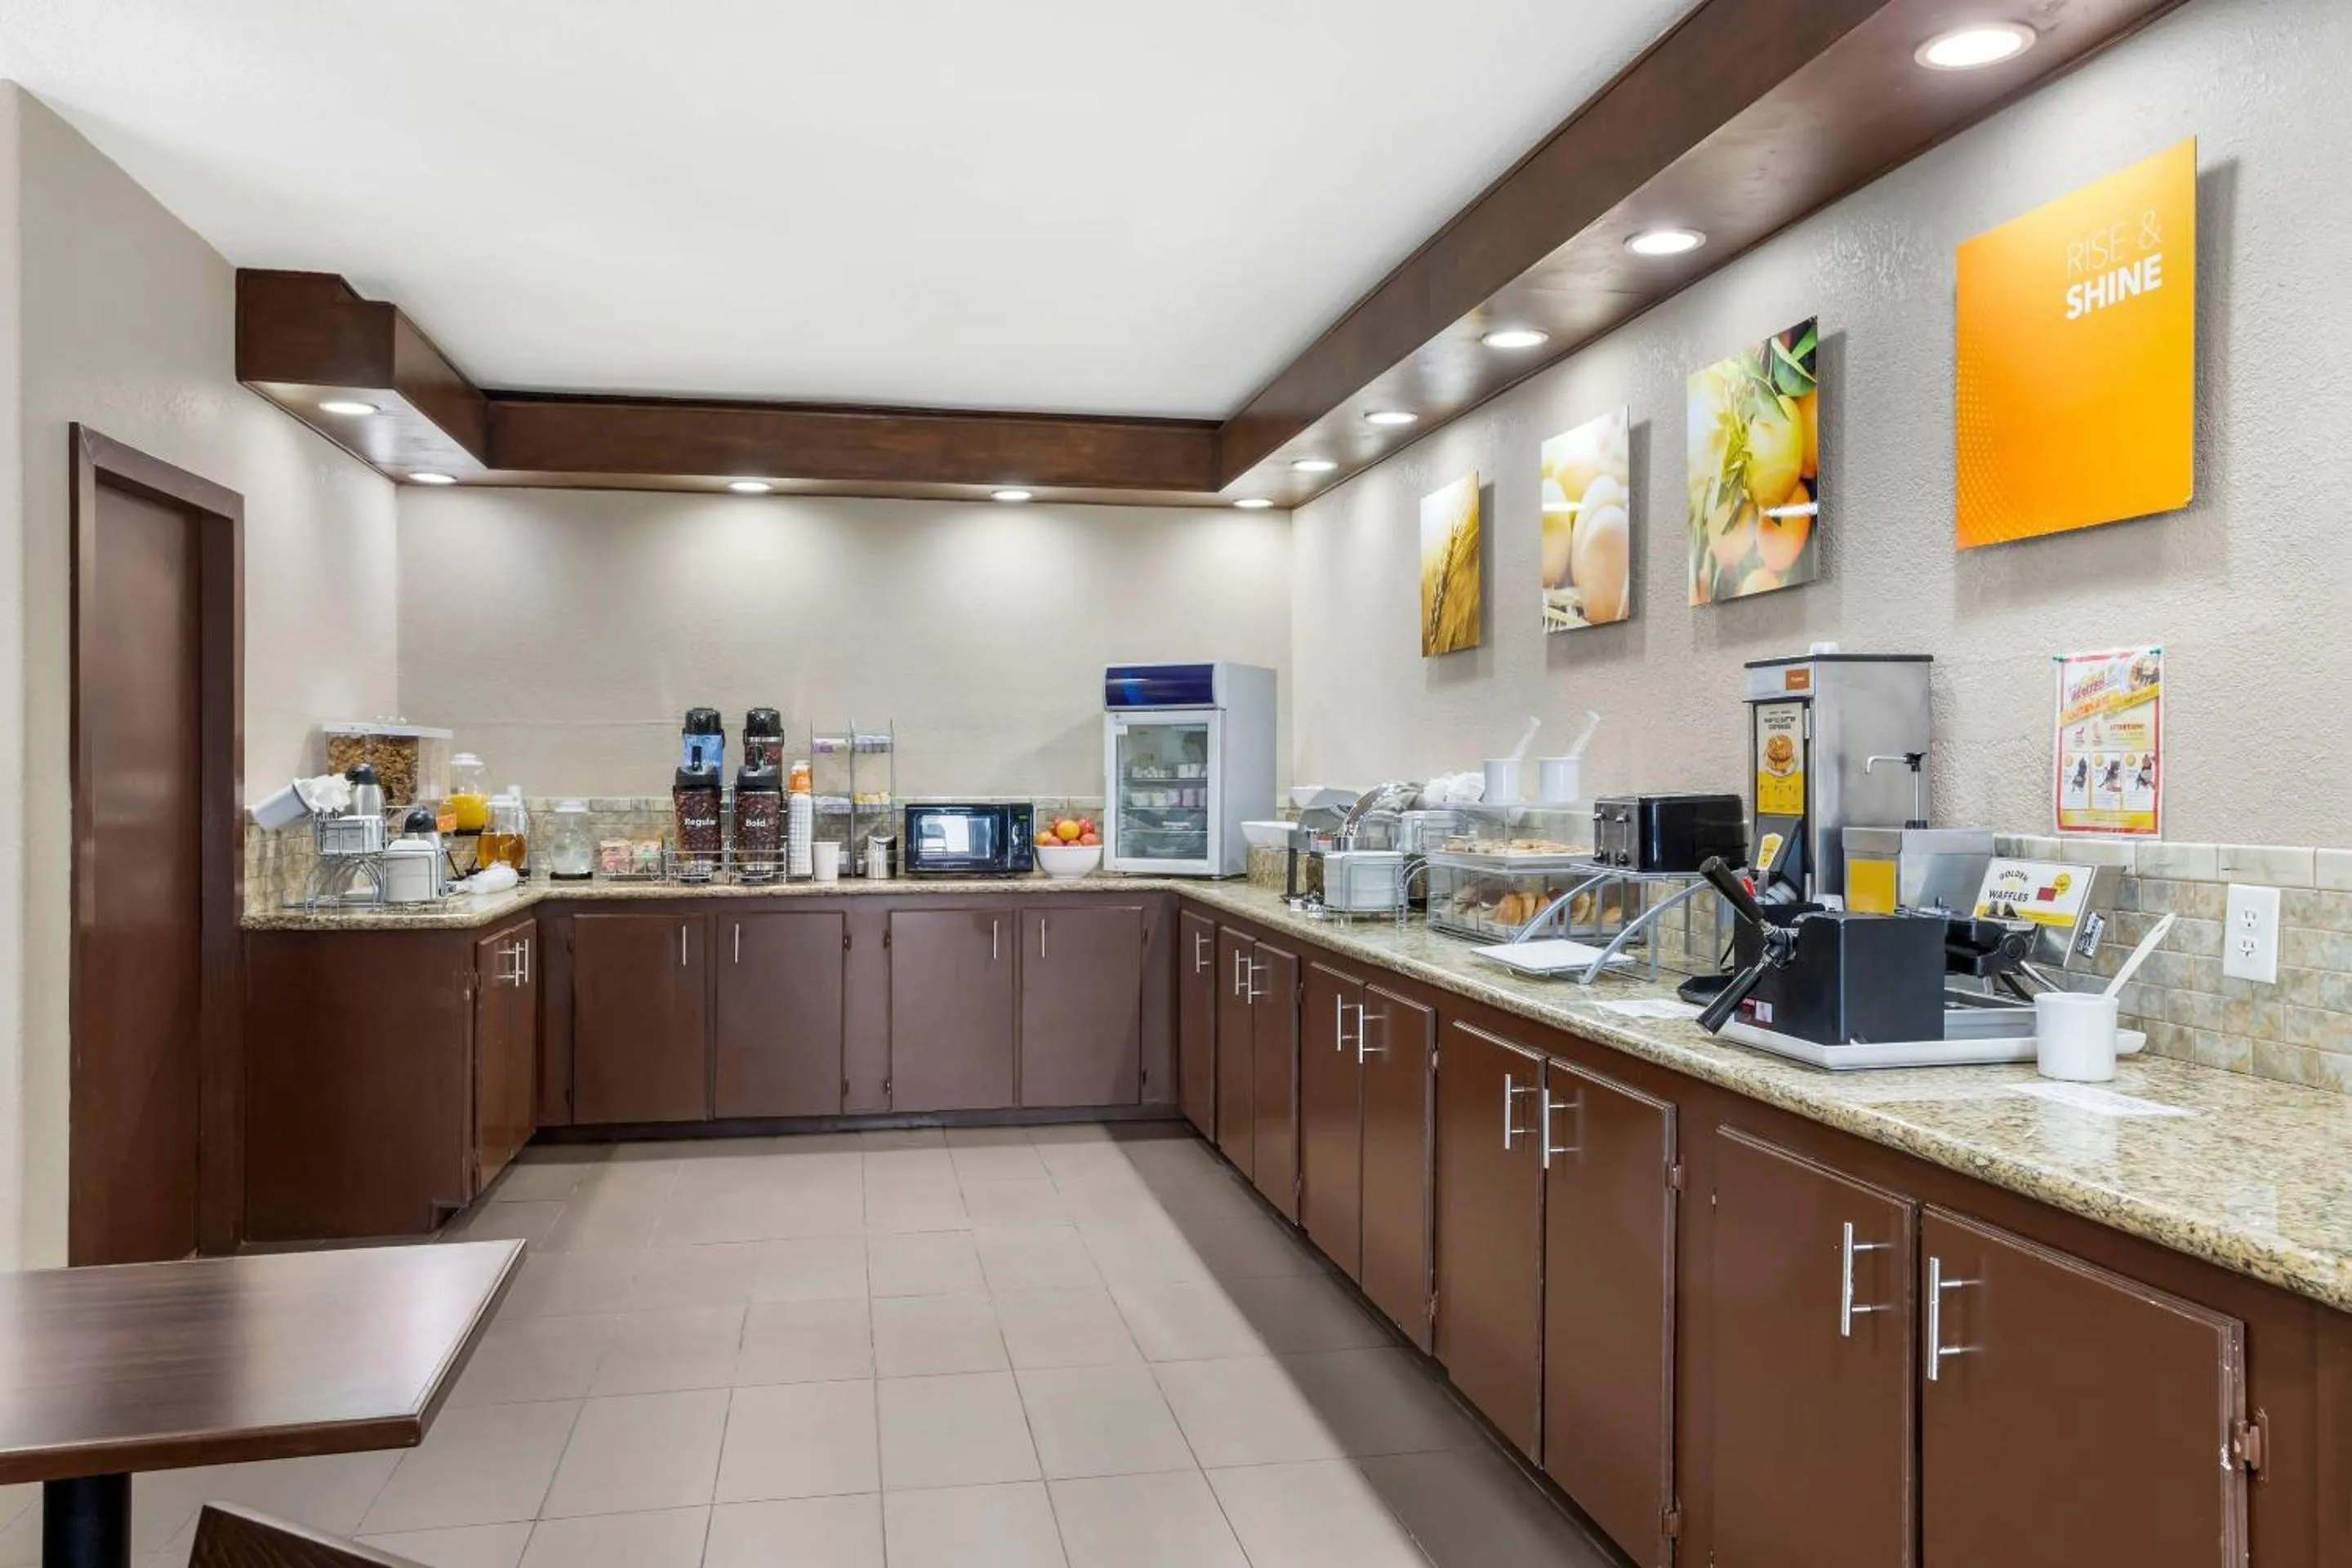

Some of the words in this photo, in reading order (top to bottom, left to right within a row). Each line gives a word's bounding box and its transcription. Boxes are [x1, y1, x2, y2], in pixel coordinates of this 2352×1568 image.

[2067, 222, 2127, 280] RISE
[2138, 211, 2162, 249] &
[2066, 253, 2163, 319] SHINE
[746, 818, 765, 826] Bold
[1999, 870, 2029, 882] GOLDEN
[1989, 890, 2029, 902] WAFFLES
